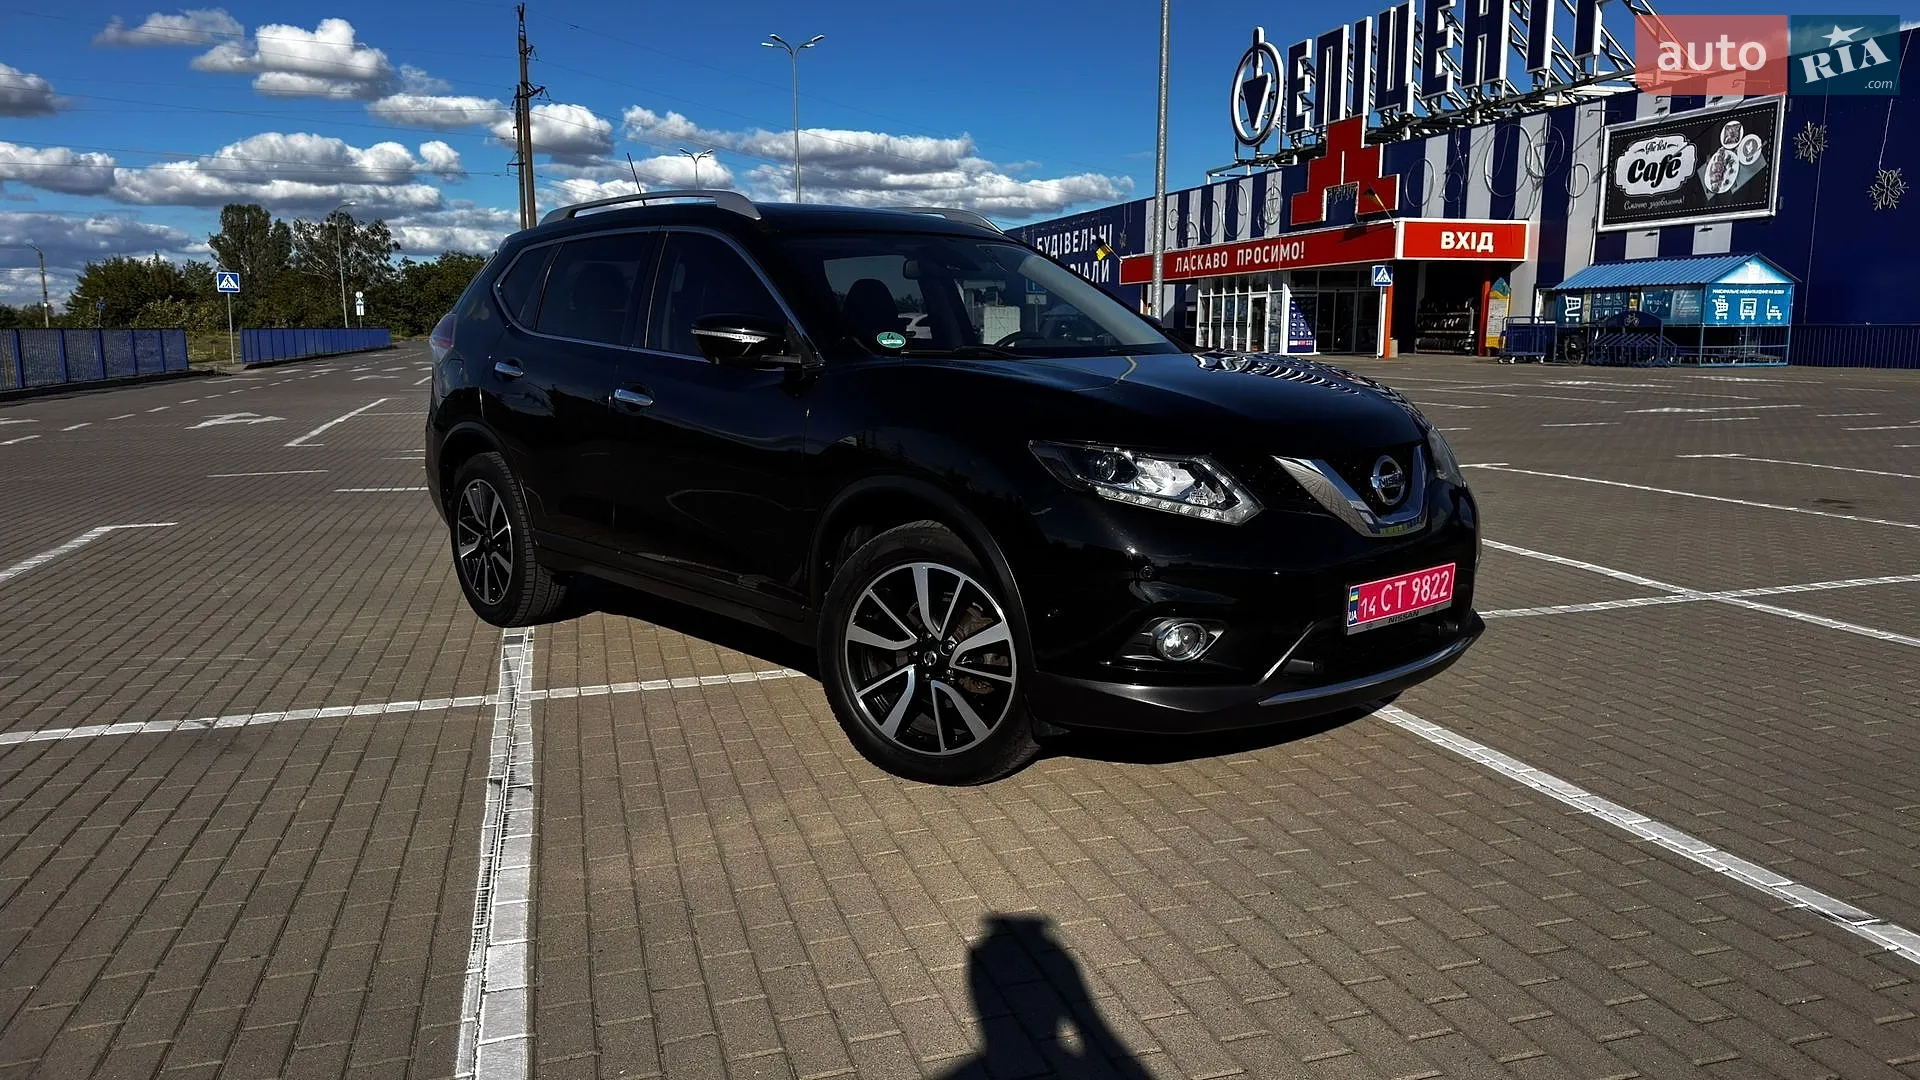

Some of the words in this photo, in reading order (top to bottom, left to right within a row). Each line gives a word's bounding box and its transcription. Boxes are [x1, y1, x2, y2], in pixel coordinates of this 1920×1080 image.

[1440, 231, 1494, 253] ВХІД
[1175, 249, 1229, 273] ЛАСКАВО
[1236, 240, 1305, 267] ПРОСИМО!
[1360, 595, 1377, 618] 14
[1380, 580, 1407, 612] CT
[1411, 571, 1449, 605] 9822
[1348, 610, 1357, 621] UA
[1387, 610, 1420, 624] NISSAN
